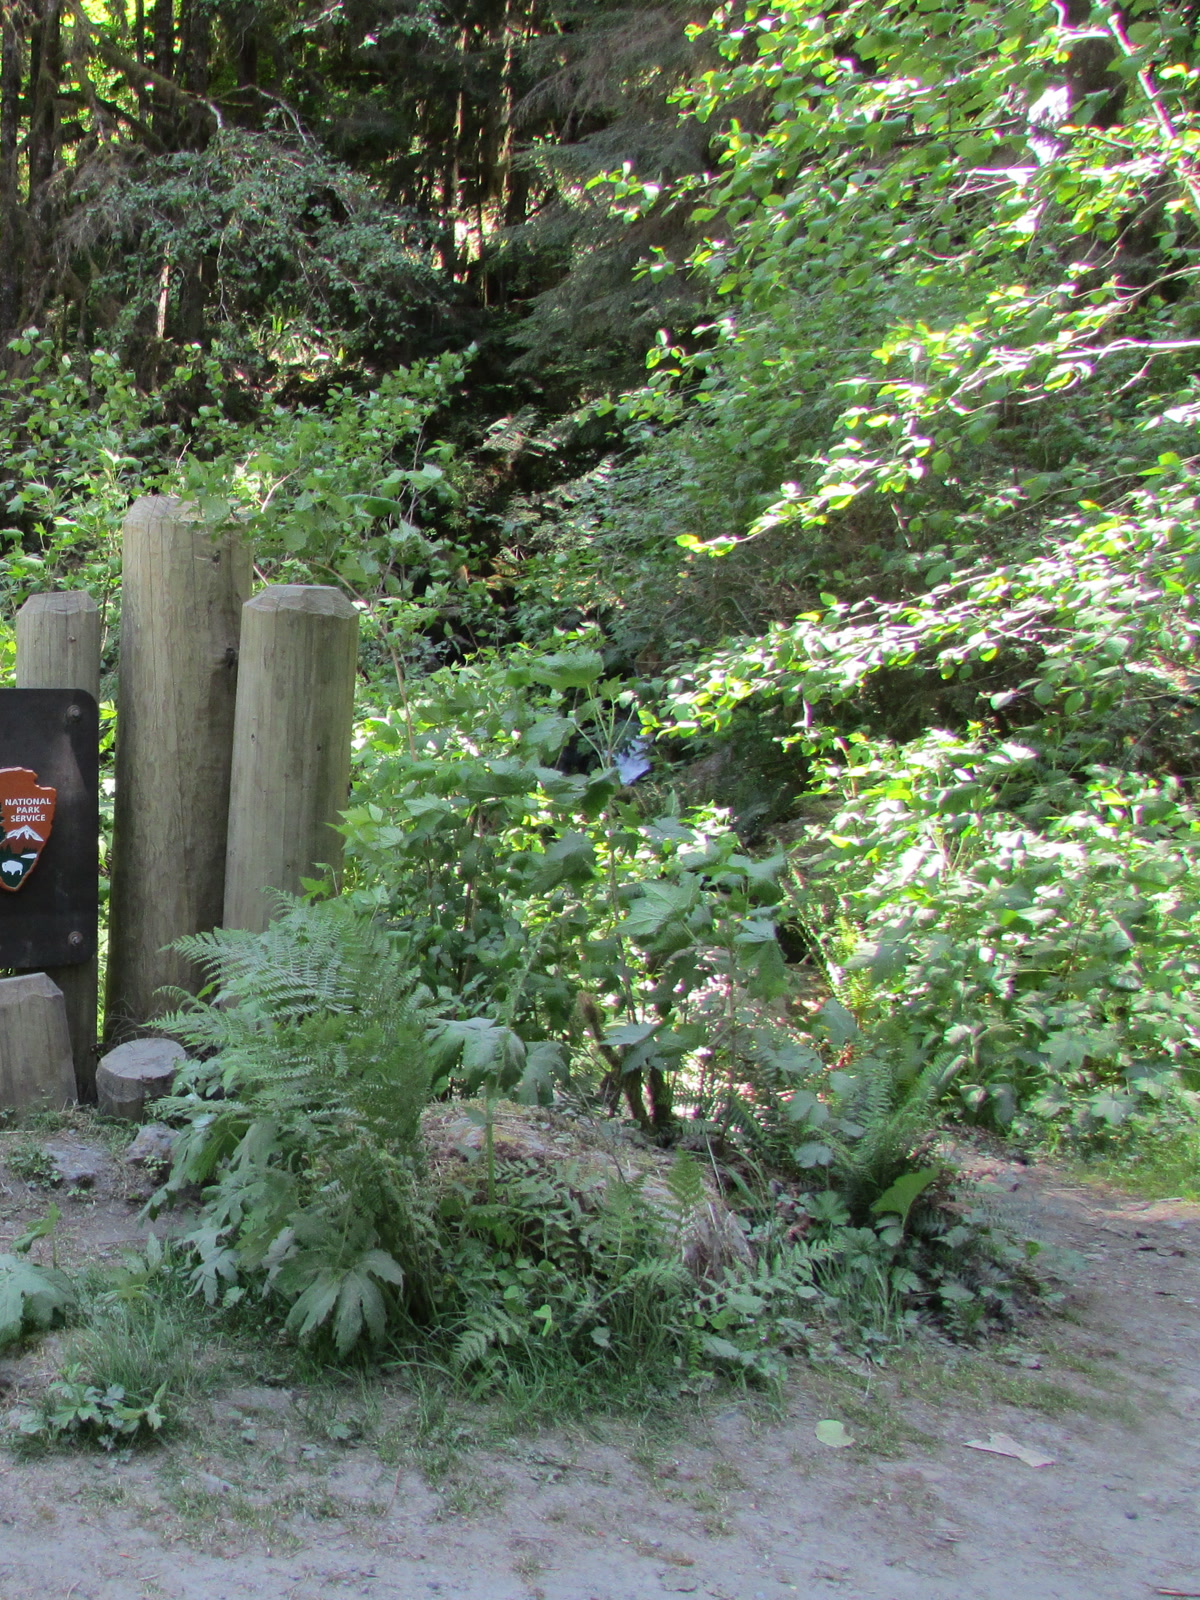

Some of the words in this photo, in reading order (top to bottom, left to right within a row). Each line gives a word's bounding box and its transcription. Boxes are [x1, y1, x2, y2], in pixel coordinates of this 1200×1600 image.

[5, 798, 51, 806] NATIONAL
[16, 806, 40, 814] PARK
[10, 814, 46, 822] SERVICE
